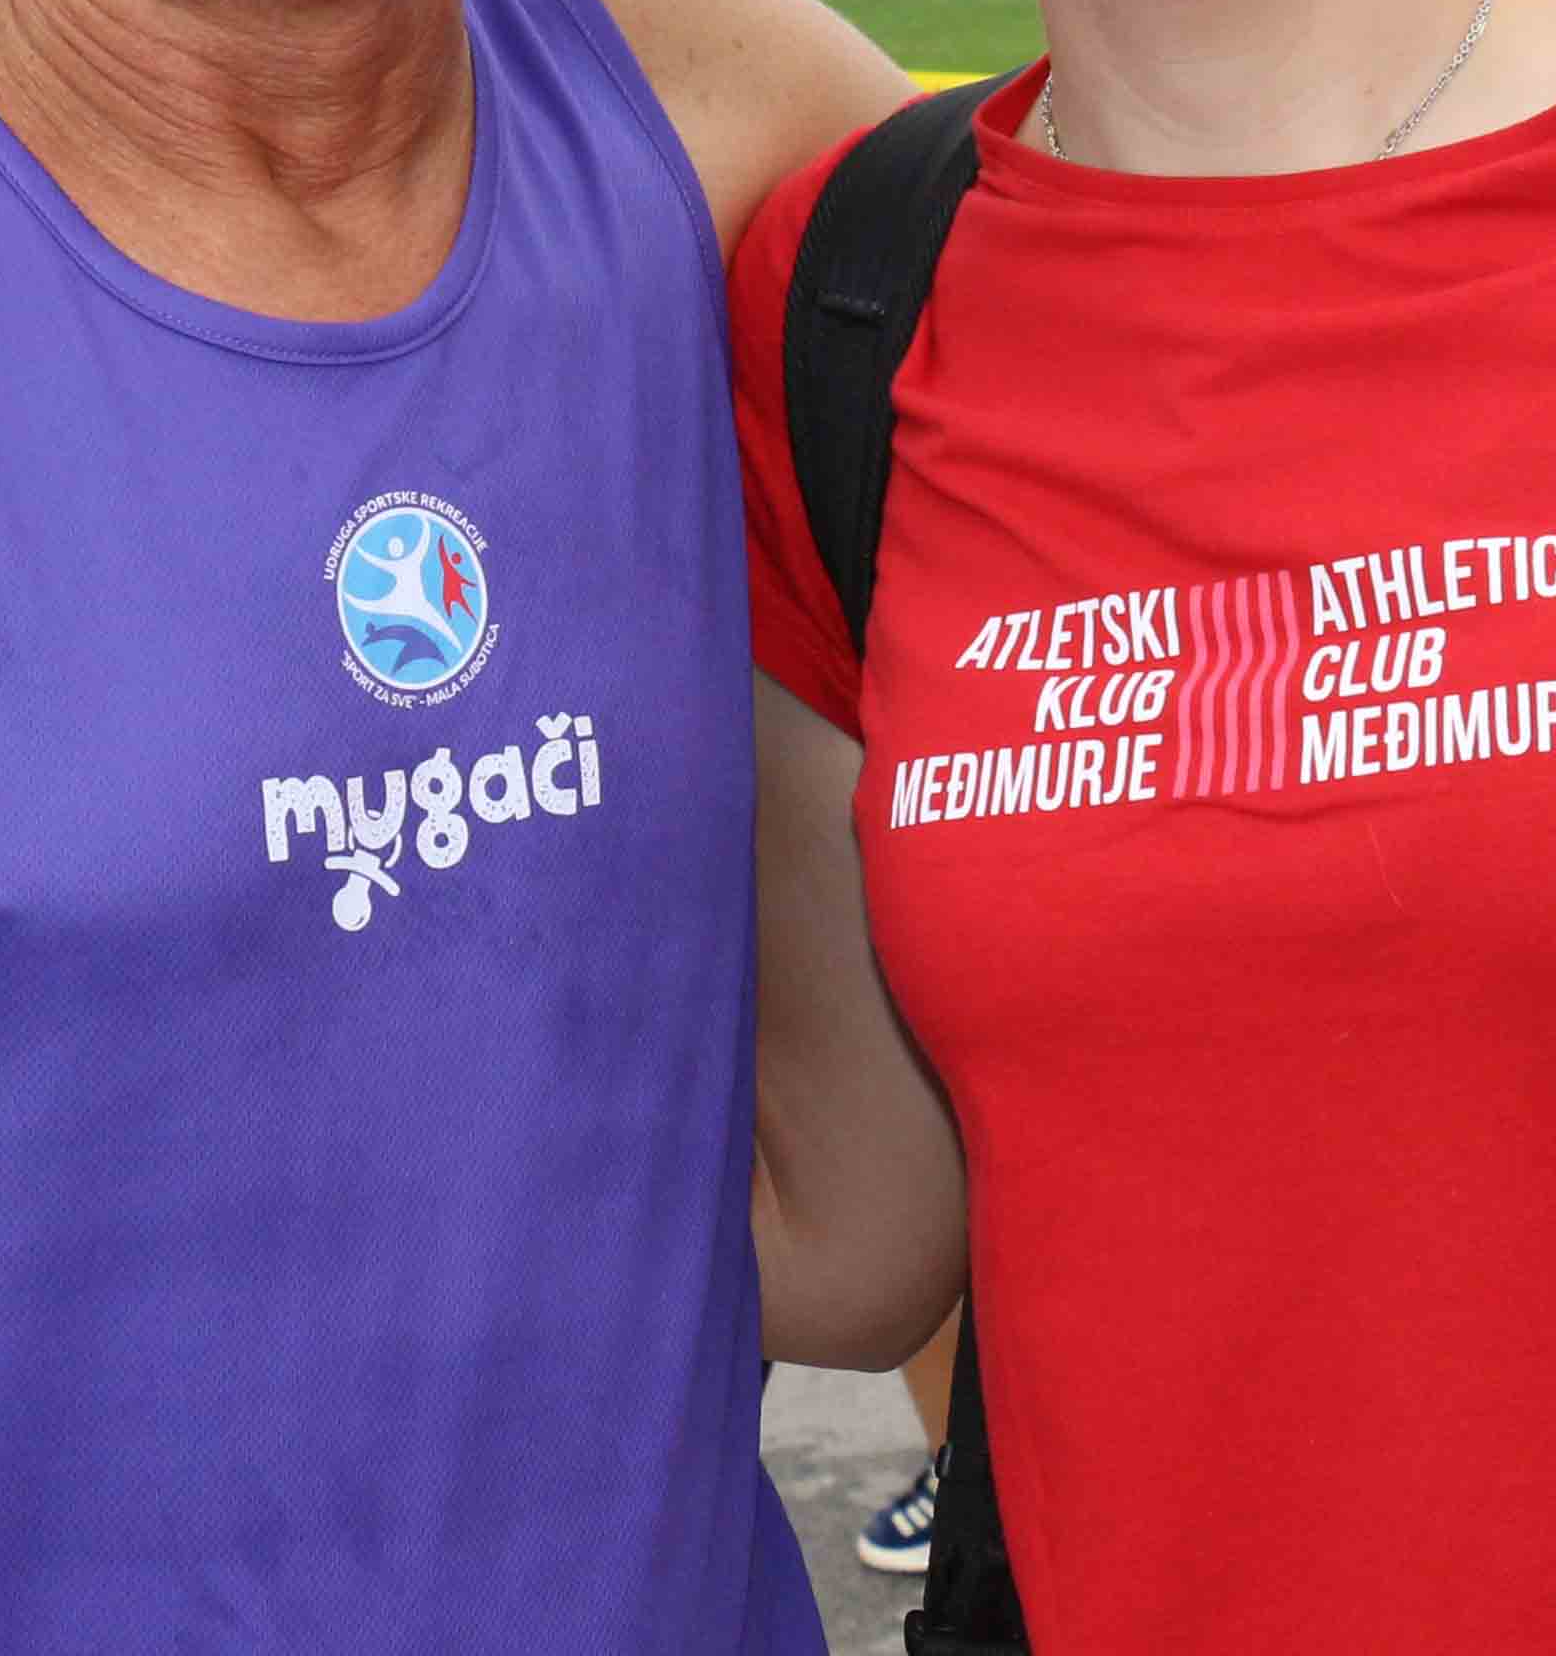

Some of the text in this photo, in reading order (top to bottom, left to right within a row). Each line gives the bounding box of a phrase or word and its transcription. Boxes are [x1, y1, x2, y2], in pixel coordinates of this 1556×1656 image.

[323, 491, 490, 581] UDRUGA SPORTSKE REKREACIJE
[373, 685, 389, 704] ZA
[426, 682, 462, 707] MALA
[459, 623, 501, 688] SUBOTICA
[954, 586, 1181, 670] ATLETSKI
[1300, 626, 1446, 702] CLUB
[1034, 667, 1175, 733] KLUB
[261, 711, 601, 869] mugači
[890, 733, 1163, 830] MEĐIMURJE
